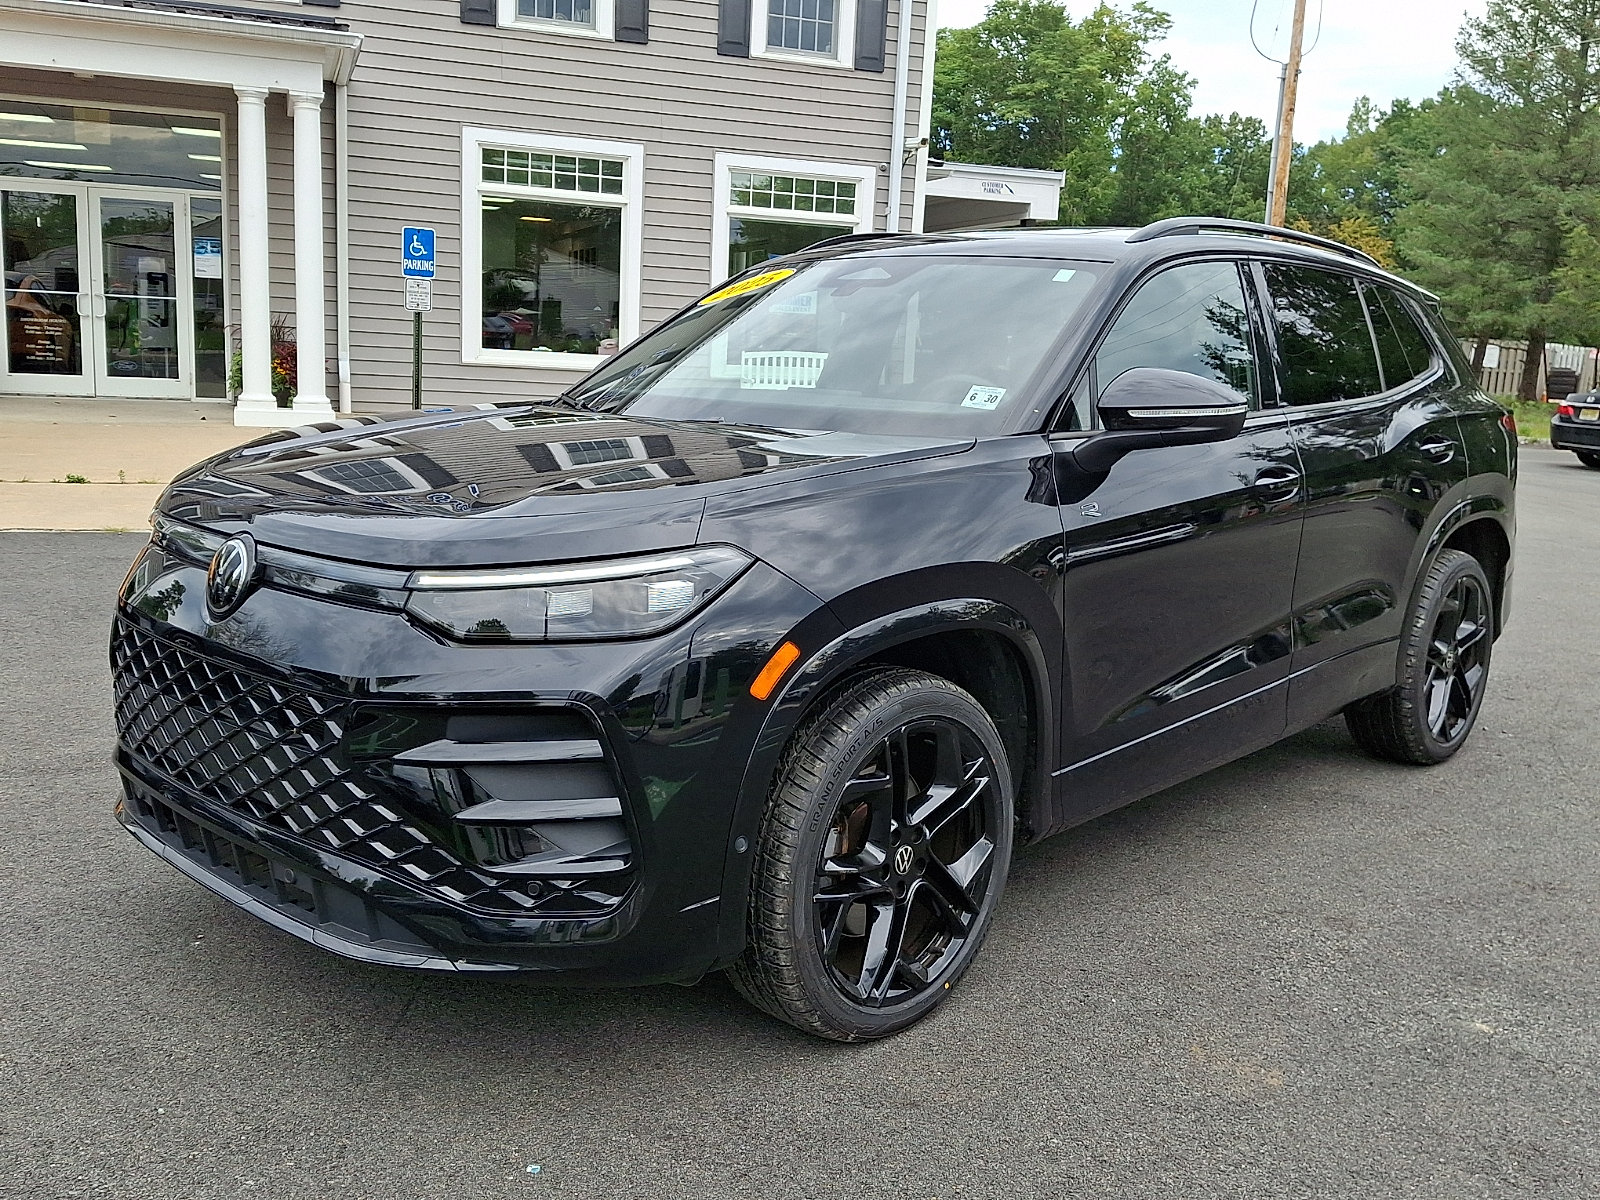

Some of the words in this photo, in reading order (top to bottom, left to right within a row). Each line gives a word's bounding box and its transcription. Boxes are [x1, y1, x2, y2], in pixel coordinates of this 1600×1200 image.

[403, 259, 434, 271] PARKING
[970, 392, 978, 401] 6
[984, 394, 999, 404] 30
[809, 781, 835, 832] GRAND
[832, 738, 864, 778] SPORT
[863, 716, 883, 739] A/S
